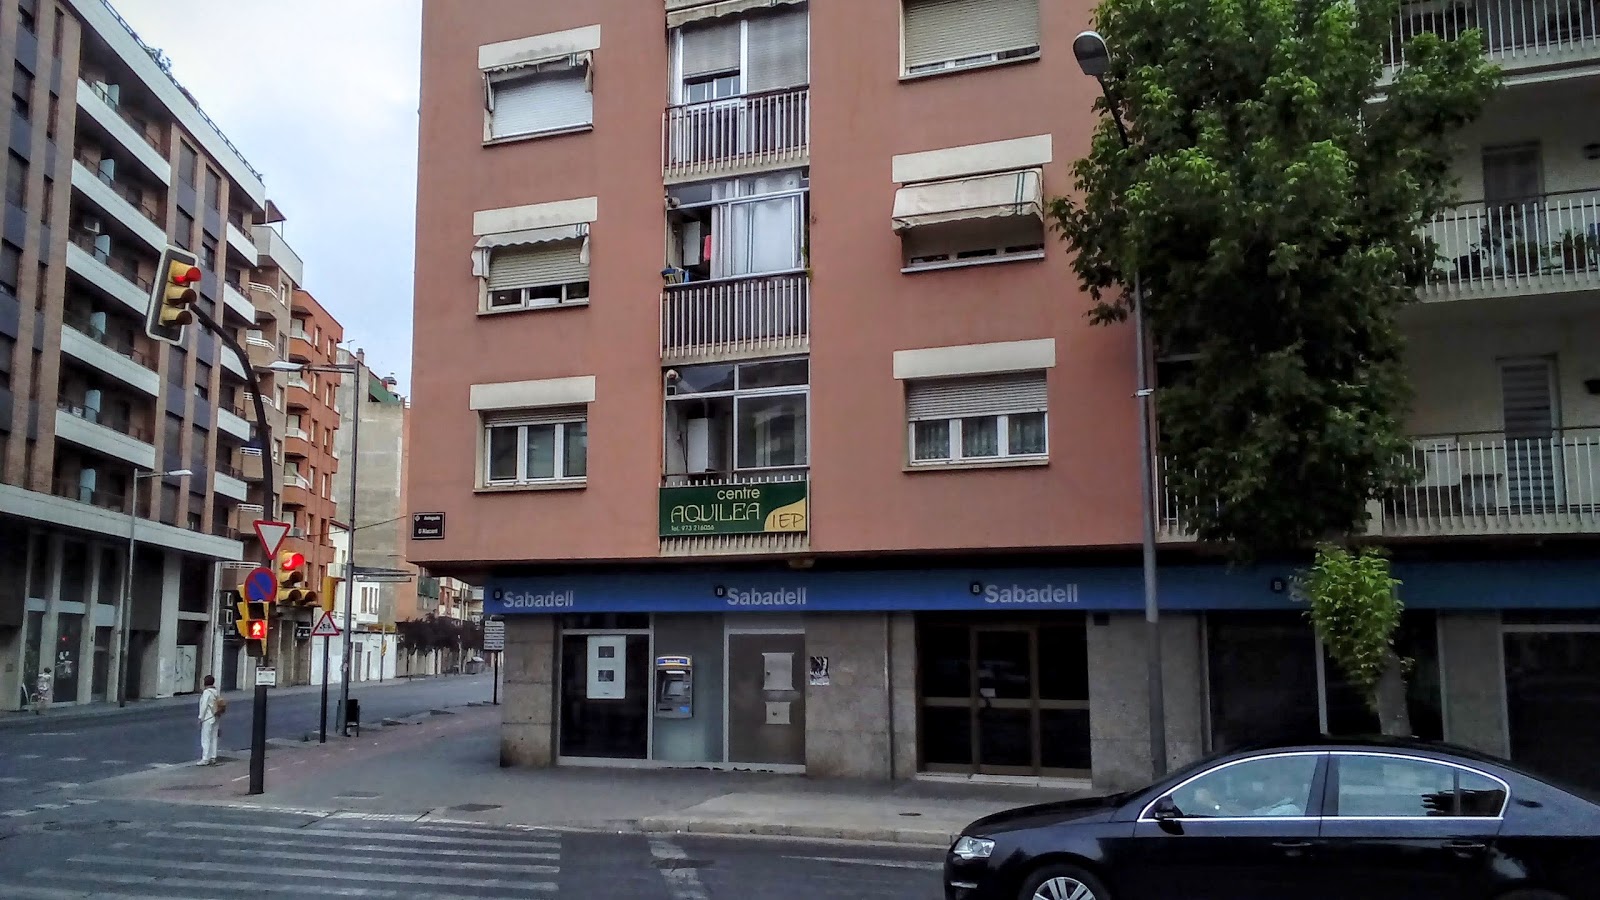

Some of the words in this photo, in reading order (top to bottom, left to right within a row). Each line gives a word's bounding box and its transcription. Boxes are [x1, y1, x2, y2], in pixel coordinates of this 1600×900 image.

[717, 487, 760, 500] centre
[671, 502, 760, 522] AQUILEA
[772, 513, 804, 528] IEP
[503, 590, 574, 608] Sabadell
[727, 587, 806, 606] Sabadell
[984, 584, 1078, 603] Sabadell
